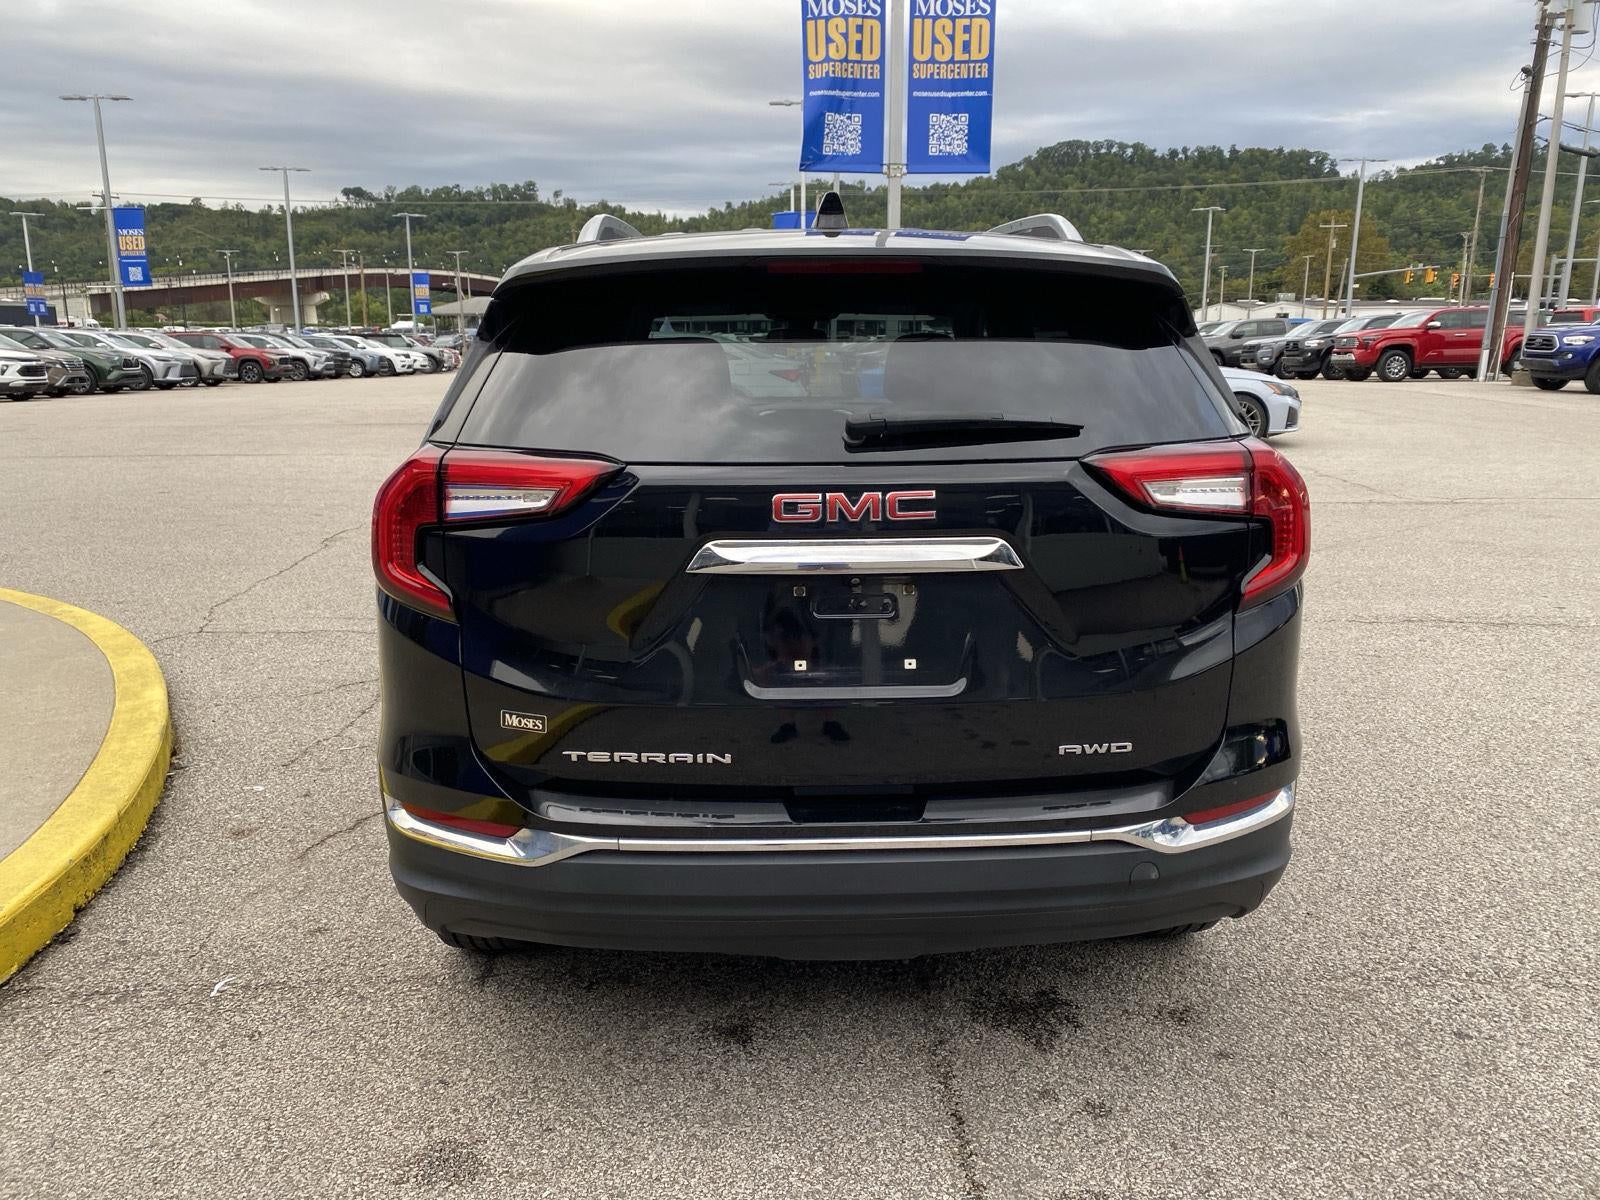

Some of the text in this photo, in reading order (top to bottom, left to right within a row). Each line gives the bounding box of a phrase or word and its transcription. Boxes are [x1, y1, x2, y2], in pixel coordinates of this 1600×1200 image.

[807, 0, 881, 17] MOSES
[914, 0, 991, 17] MOSES
[807, 17, 881, 62] USED
[913, 18, 990, 62] USED
[808, 62, 880, 79] SUPERCENTER
[912, 63, 988, 79] SUPERCENTER
[119, 236, 145, 251] USED
[771, 489, 937, 524] GMC
[1058, 742, 1133, 756] AWD
[562, 751, 732, 765] TERRAIN
